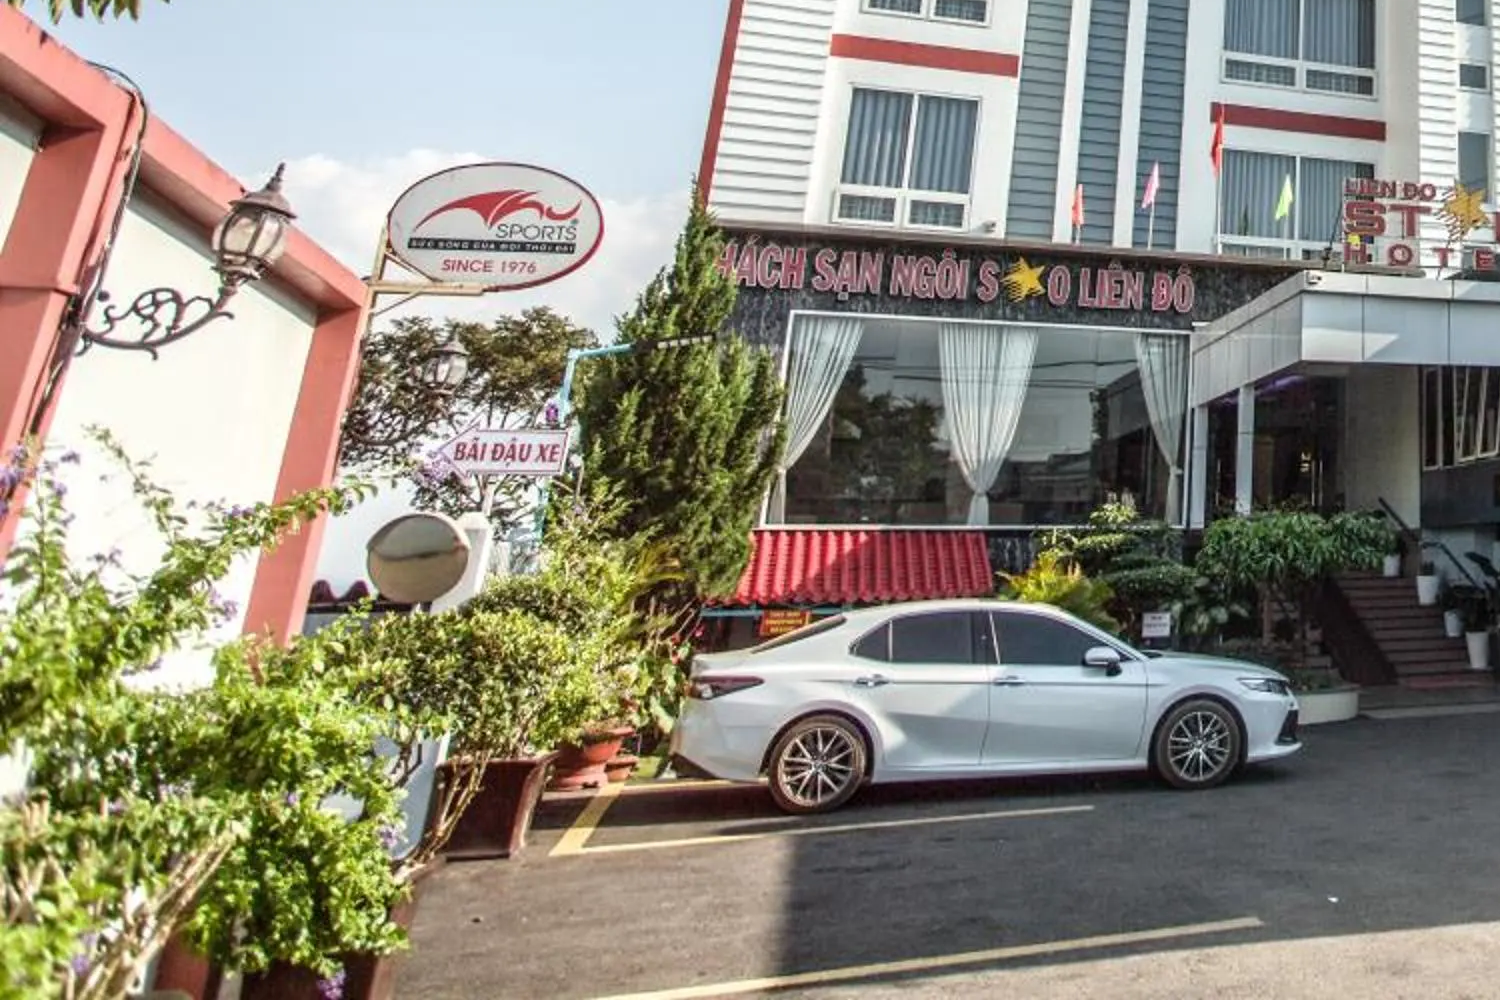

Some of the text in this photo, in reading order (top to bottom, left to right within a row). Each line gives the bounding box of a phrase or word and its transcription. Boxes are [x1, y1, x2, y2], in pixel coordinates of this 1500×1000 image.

[1344, 178, 1396, 198] LIEN
[496, 222, 577, 241] SPORTS
[441, 258, 537, 275] SINCE 1976
[811, 247, 884, 301] SẠN
[889, 247, 970, 300] NGÔI
[1078, 258, 1145, 310] LIÊN
[1151, 264, 1196, 313] ĐÔ
[453, 436, 488, 462] BÃI
[535, 442, 561, 463] XE
